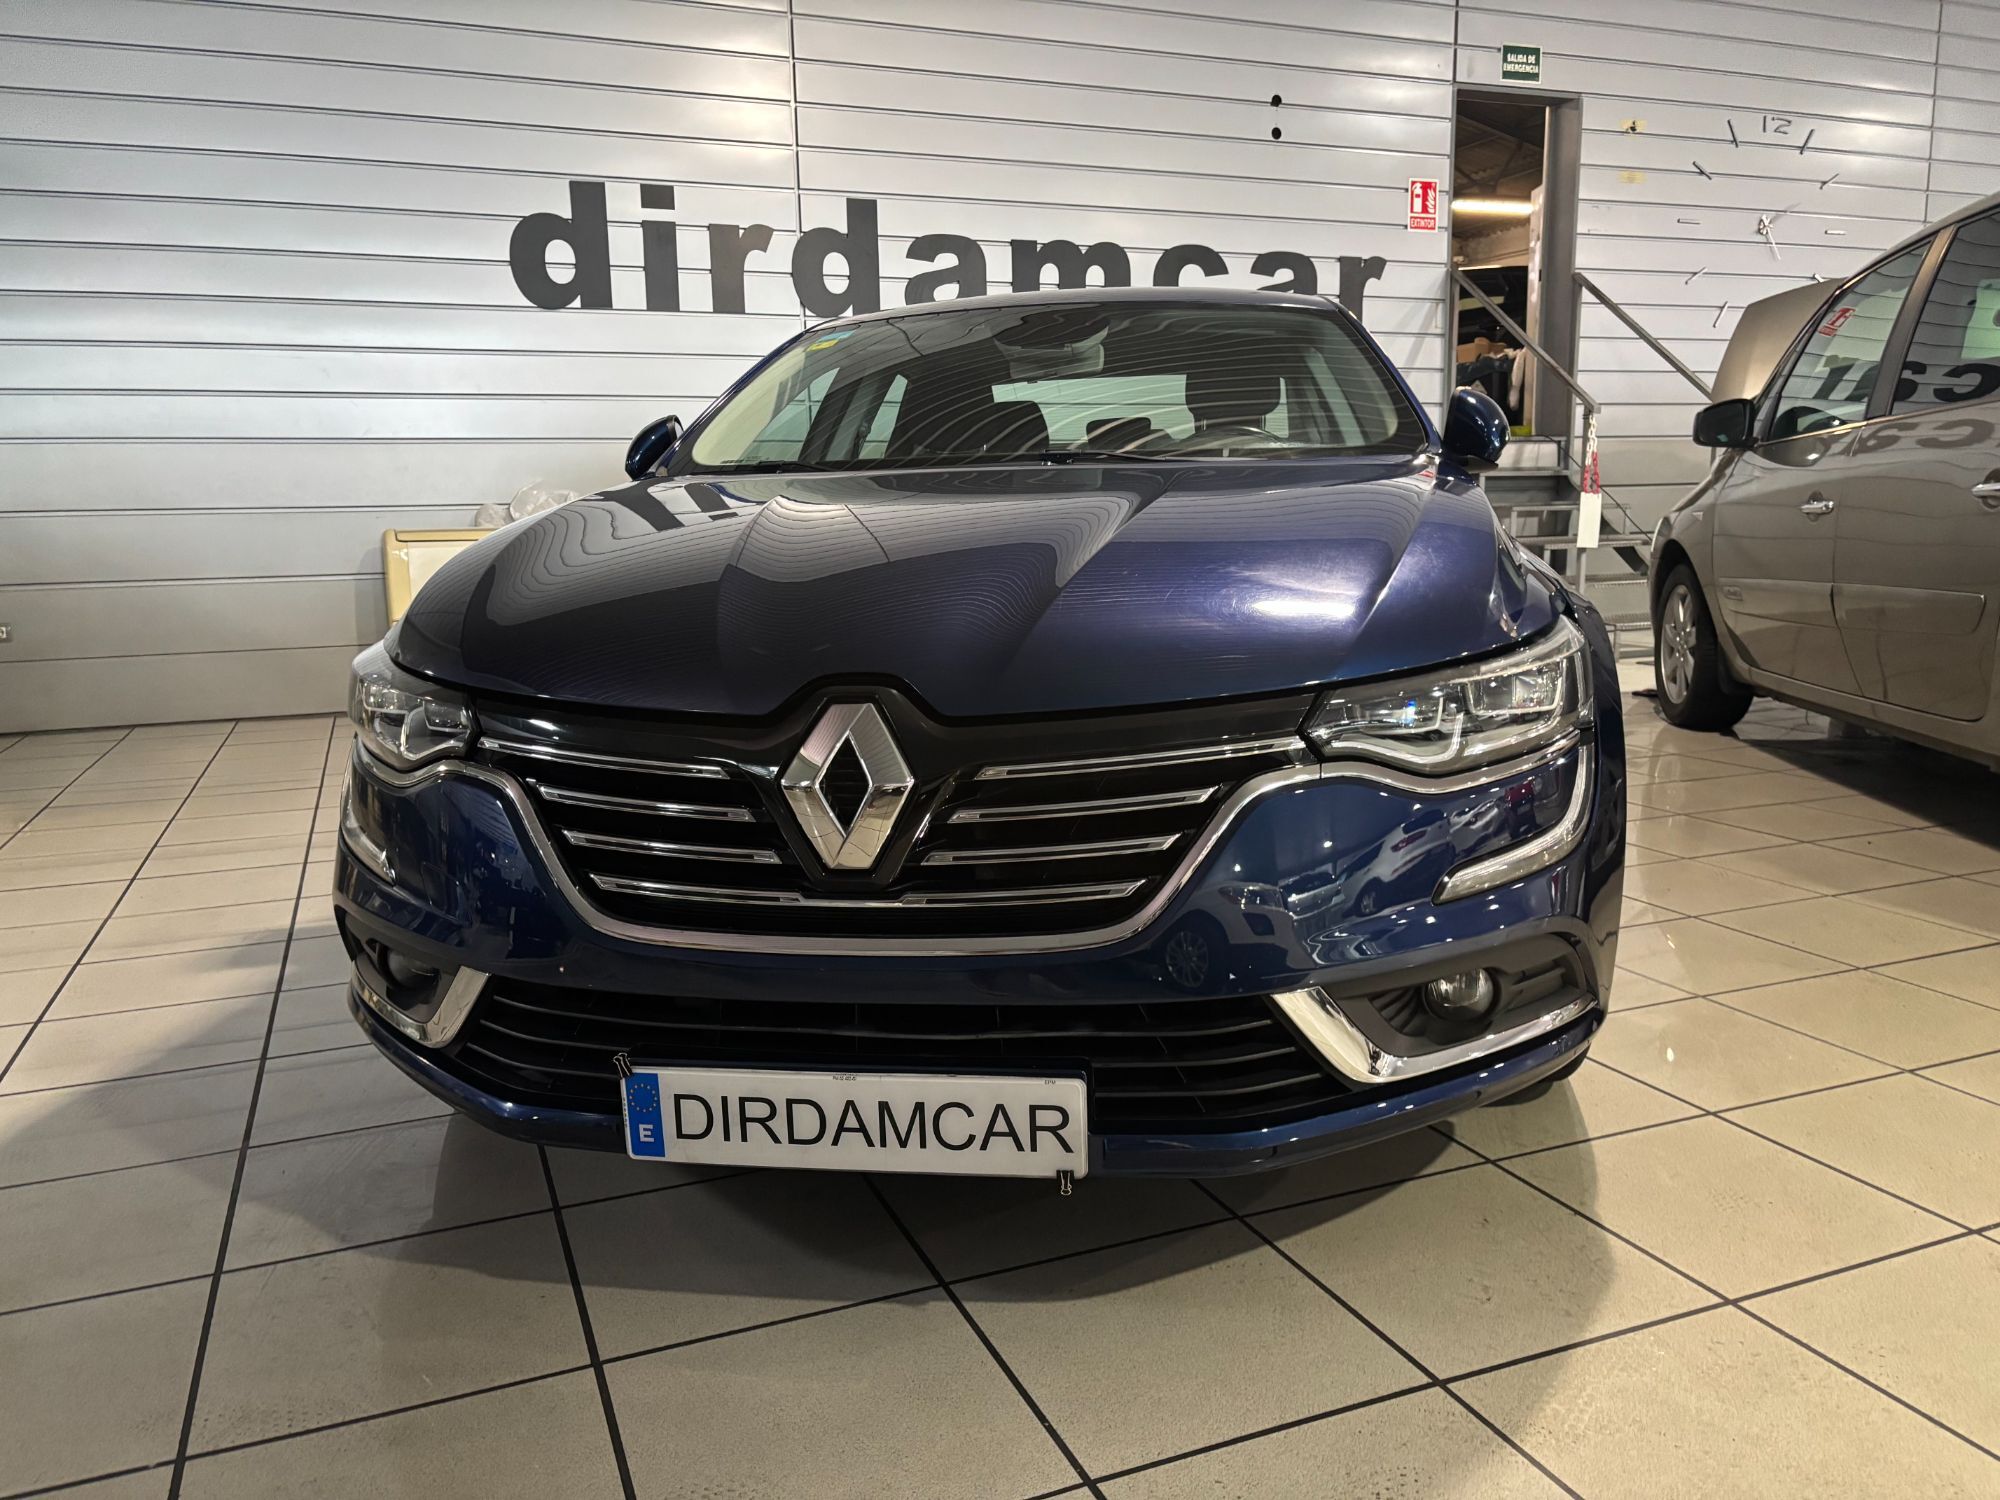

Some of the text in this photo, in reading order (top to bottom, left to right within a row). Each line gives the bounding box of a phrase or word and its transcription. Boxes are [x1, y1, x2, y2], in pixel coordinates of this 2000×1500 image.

[1507, 53, 1536, 64] SALIDA DE
[1503, 62, 1539, 73] EMERGENCIA
[1410, 217, 1435, 228] EXTINTOR
[673, 1093, 1075, 1154] DIRDAMCAR
[639, 1124, 655, 1142] E
